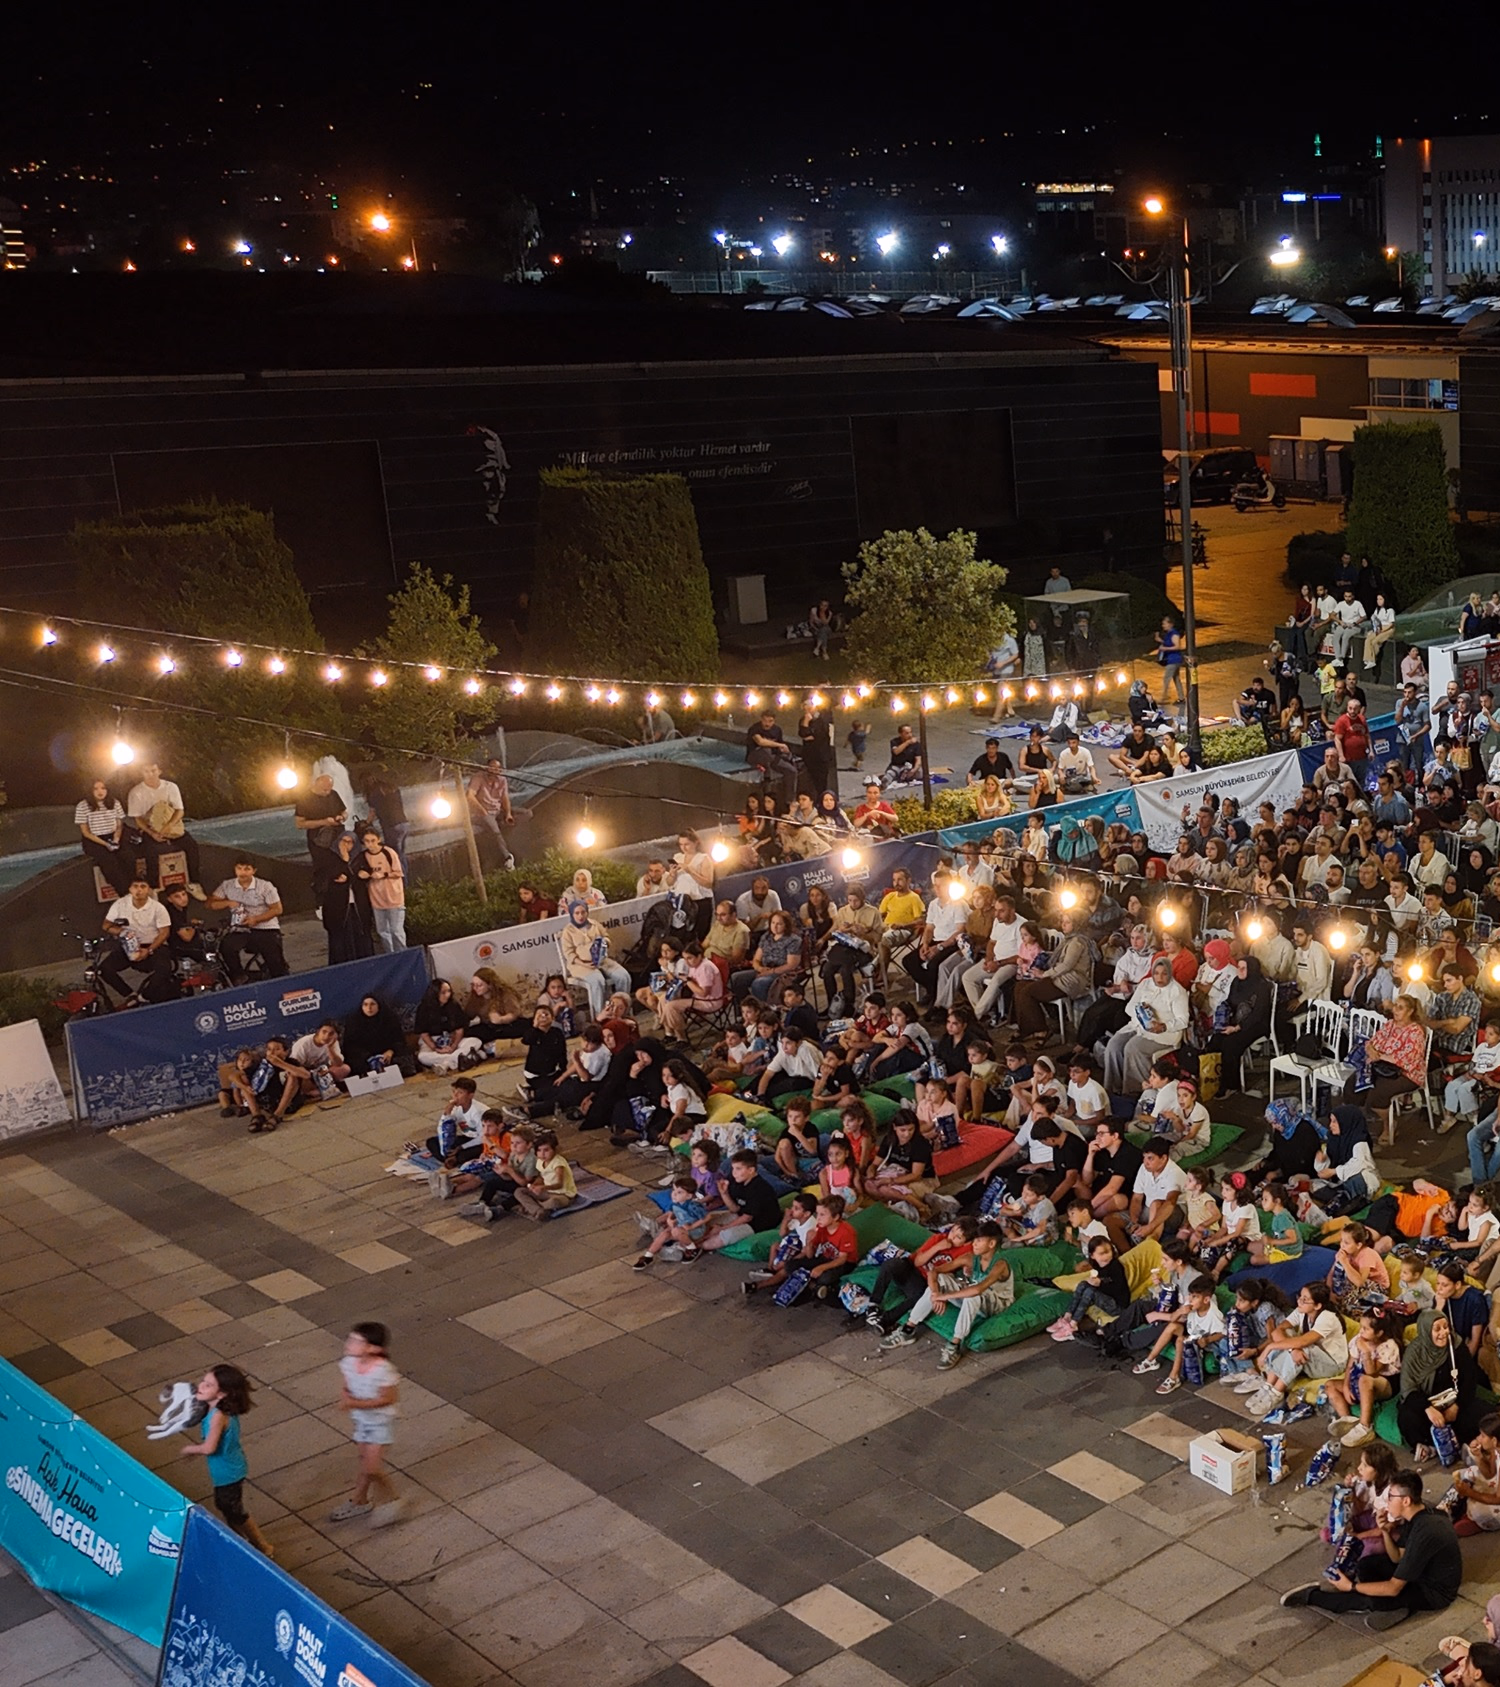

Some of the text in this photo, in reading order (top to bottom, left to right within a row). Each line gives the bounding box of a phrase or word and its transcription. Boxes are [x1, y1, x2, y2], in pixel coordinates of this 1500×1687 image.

[1175, 786, 1204, 799] SAMSUN
[1204, 776, 1246, 793] BÜYÜKŞEHİR
[502, 934, 550, 954] SAMSUN
[57, 1474, 99, 1522] Hava
[13, 1465, 119, 1576] SİNEMA GECELERİ
